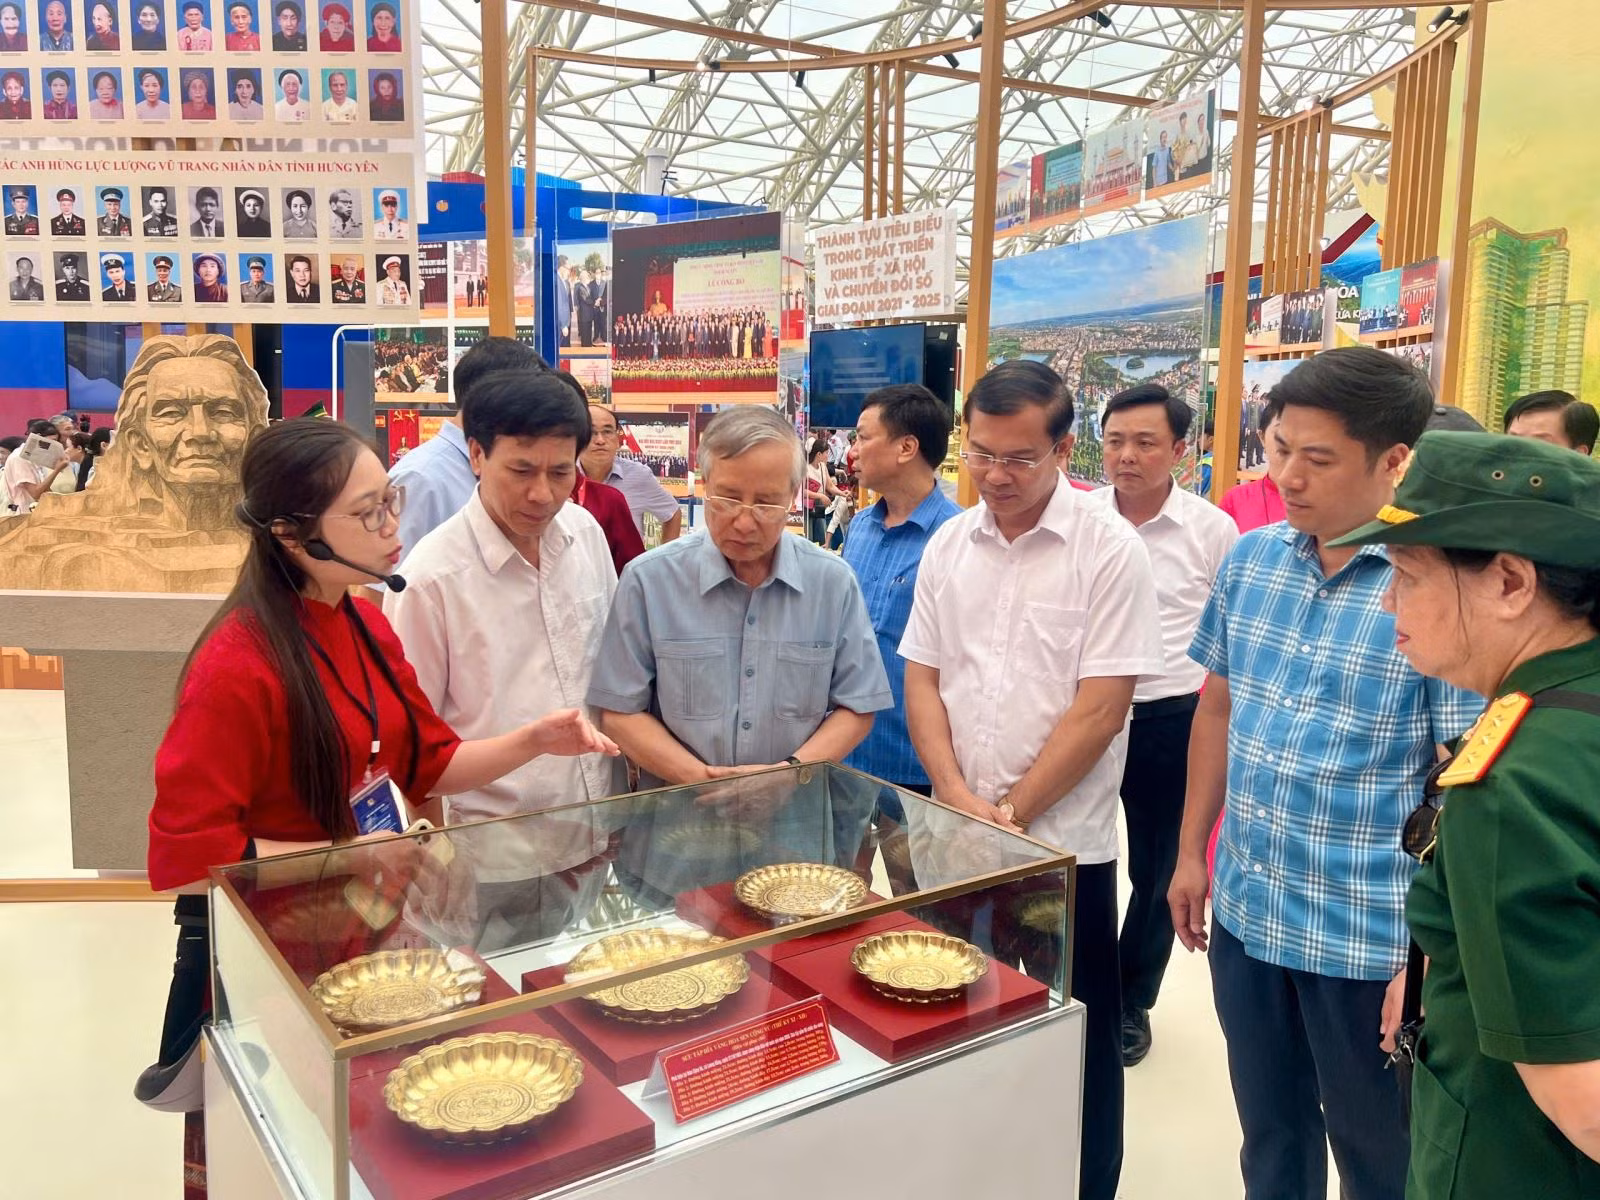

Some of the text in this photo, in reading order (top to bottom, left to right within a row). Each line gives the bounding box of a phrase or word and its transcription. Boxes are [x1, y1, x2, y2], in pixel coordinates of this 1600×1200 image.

[0, 157, 380, 174] ÁC ANH HÙNG LỰC LƯỢNG VŨ TRANG NHÂN DÂN TỈNH HƯNG YÊN
[816, 212, 943, 249] THÀNH TỰU TIÊU BIỂU
[823, 233, 935, 266] TRONG PHÁT TRIỂN
[830, 266, 859, 282] KINH
[860, 259, 876, 278] TẾ
[883, 257, 901, 275] XÃ
[903, 254, 926, 275] HỘI
[823, 269, 934, 300] VÀ CHUYỂN ĐỔI SỐ
[816, 303, 840, 318] GIAI
[841, 299, 876, 318] ĐOẠN
[877, 296, 903, 313] 2021
[912, 292, 942, 308] 2025
